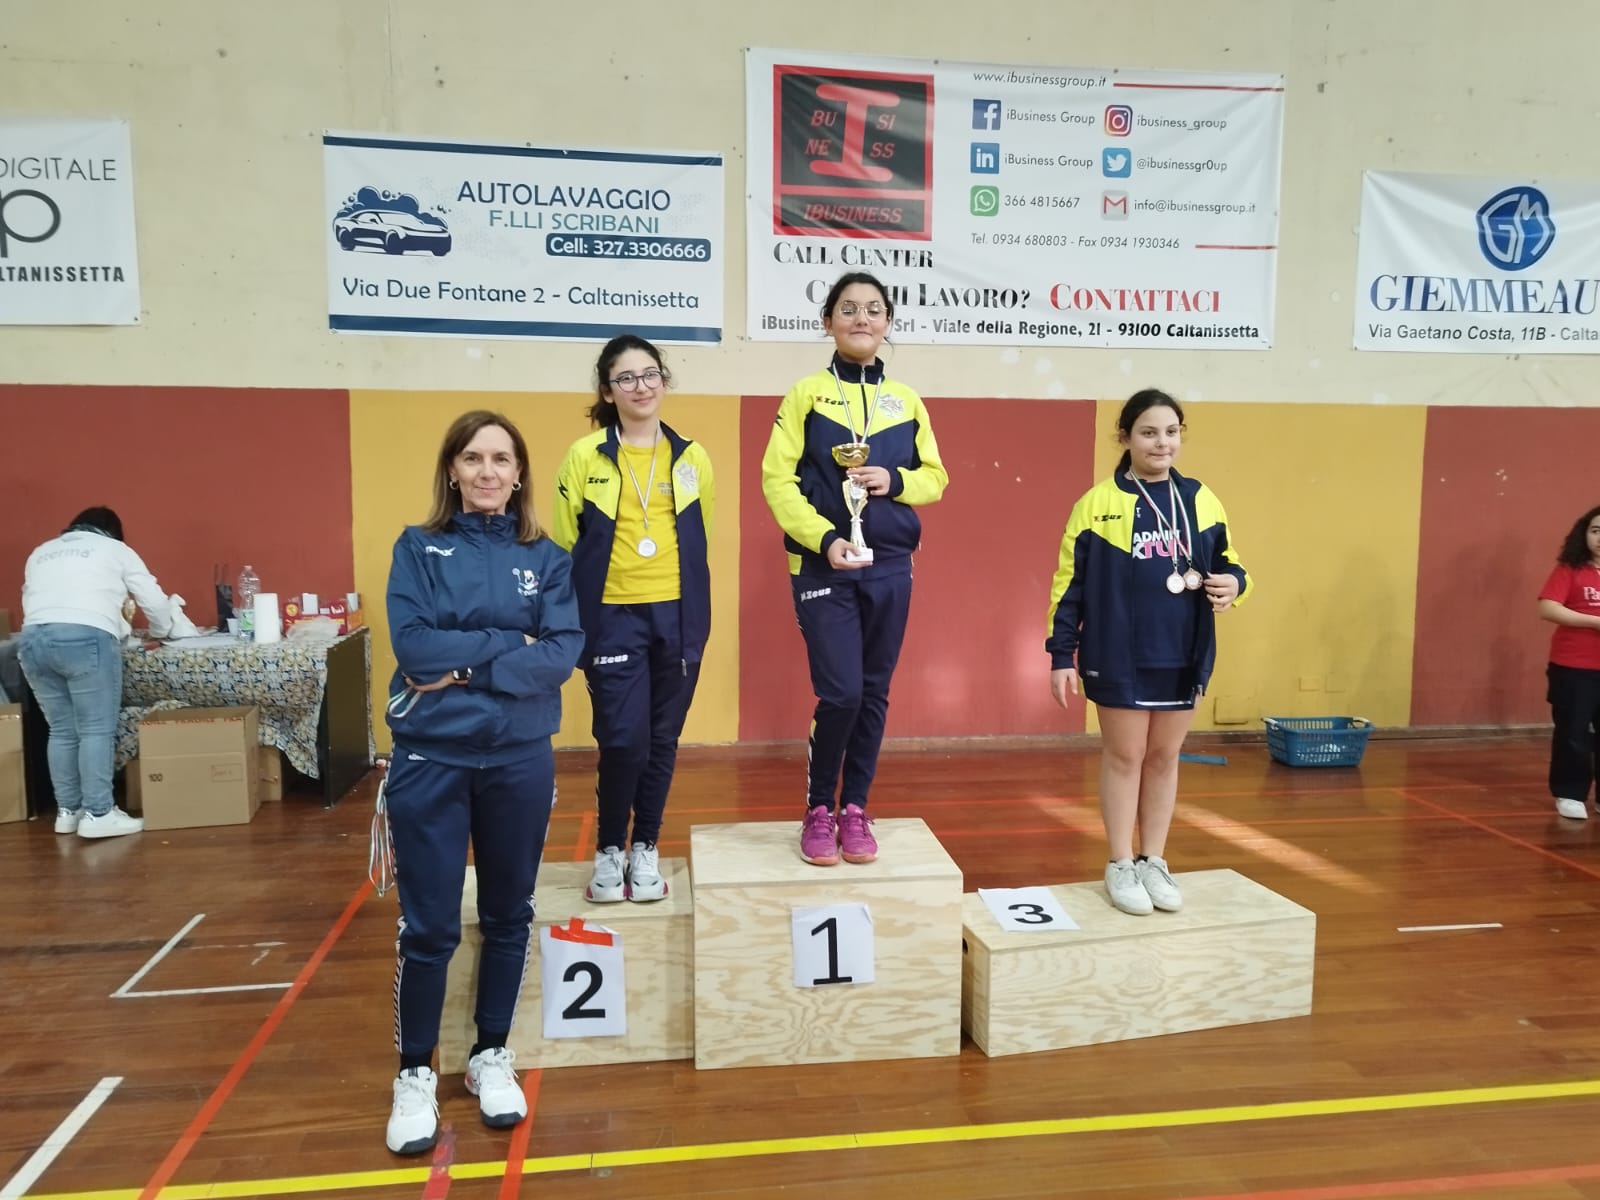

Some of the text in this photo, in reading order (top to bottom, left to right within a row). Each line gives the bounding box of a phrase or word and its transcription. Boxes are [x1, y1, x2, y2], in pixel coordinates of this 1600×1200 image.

[972, 71, 1107, 89] www.ibusinessgroup.it
[810, 109, 897, 132] BU SI
[1006, 108, 1096, 125] iBusiness Group
[1136, 115, 1228, 131] ibusiness_group
[803, 137, 896, 159] NE SS
[1004, 153, 1094, 170] iBusiness Group
[456, 181, 671, 211] AUTOLAVAGGIO
[1004, 195, 1081, 208] 366 4815667
[1134, 199, 1257, 214] info@ibusinessgroup.it
[489, 209, 660, 234] F.LLI SCRIBANI
[549, 236, 707, 259] Cell: 327.3306666
[971, 232, 988, 244] Tel.
[992, 233, 1021, 245] 0934
[1024, 234, 1068, 246] 680803
[1078, 236, 1098, 247] Fax
[1100, 236, 1128, 248] 0934
[1132, 237, 1180, 249] 1930346
[773, 241, 934, 268] CALL CENTER
[342, 277, 380, 297] Via
[387, 279, 431, 299] Due
[438, 281, 527, 303] Fontane
[533, 287, 546, 304] 2
[567, 286, 700, 309] Caltanissetta
[918, 283, 1032, 310] LAVORO?
[1049, 283, 1221, 313] CONTATTACI
[894, 318, 915, 333] Srl
[932, 319, 971, 334] Viale
[976, 320, 1013, 335] della
[1018, 321, 1082, 338] Regione,
[1088, 322, 1101, 335] 21
[1118, 323, 1162, 337] 93100
[1166, 324, 1259, 338] Caltanissetta
[1368, 323, 1392, 339] Via
[1396, 325, 1462, 340] Gaetano
[1467, 326, 1515, 342] Costa,
[1521, 327, 1546, 341] 11B
[1560, 327, 1599, 341] Calta
[1008, 903, 1054, 924] 3
[811, 917, 853, 986] 1
[562, 961, 606, 1020] 2
